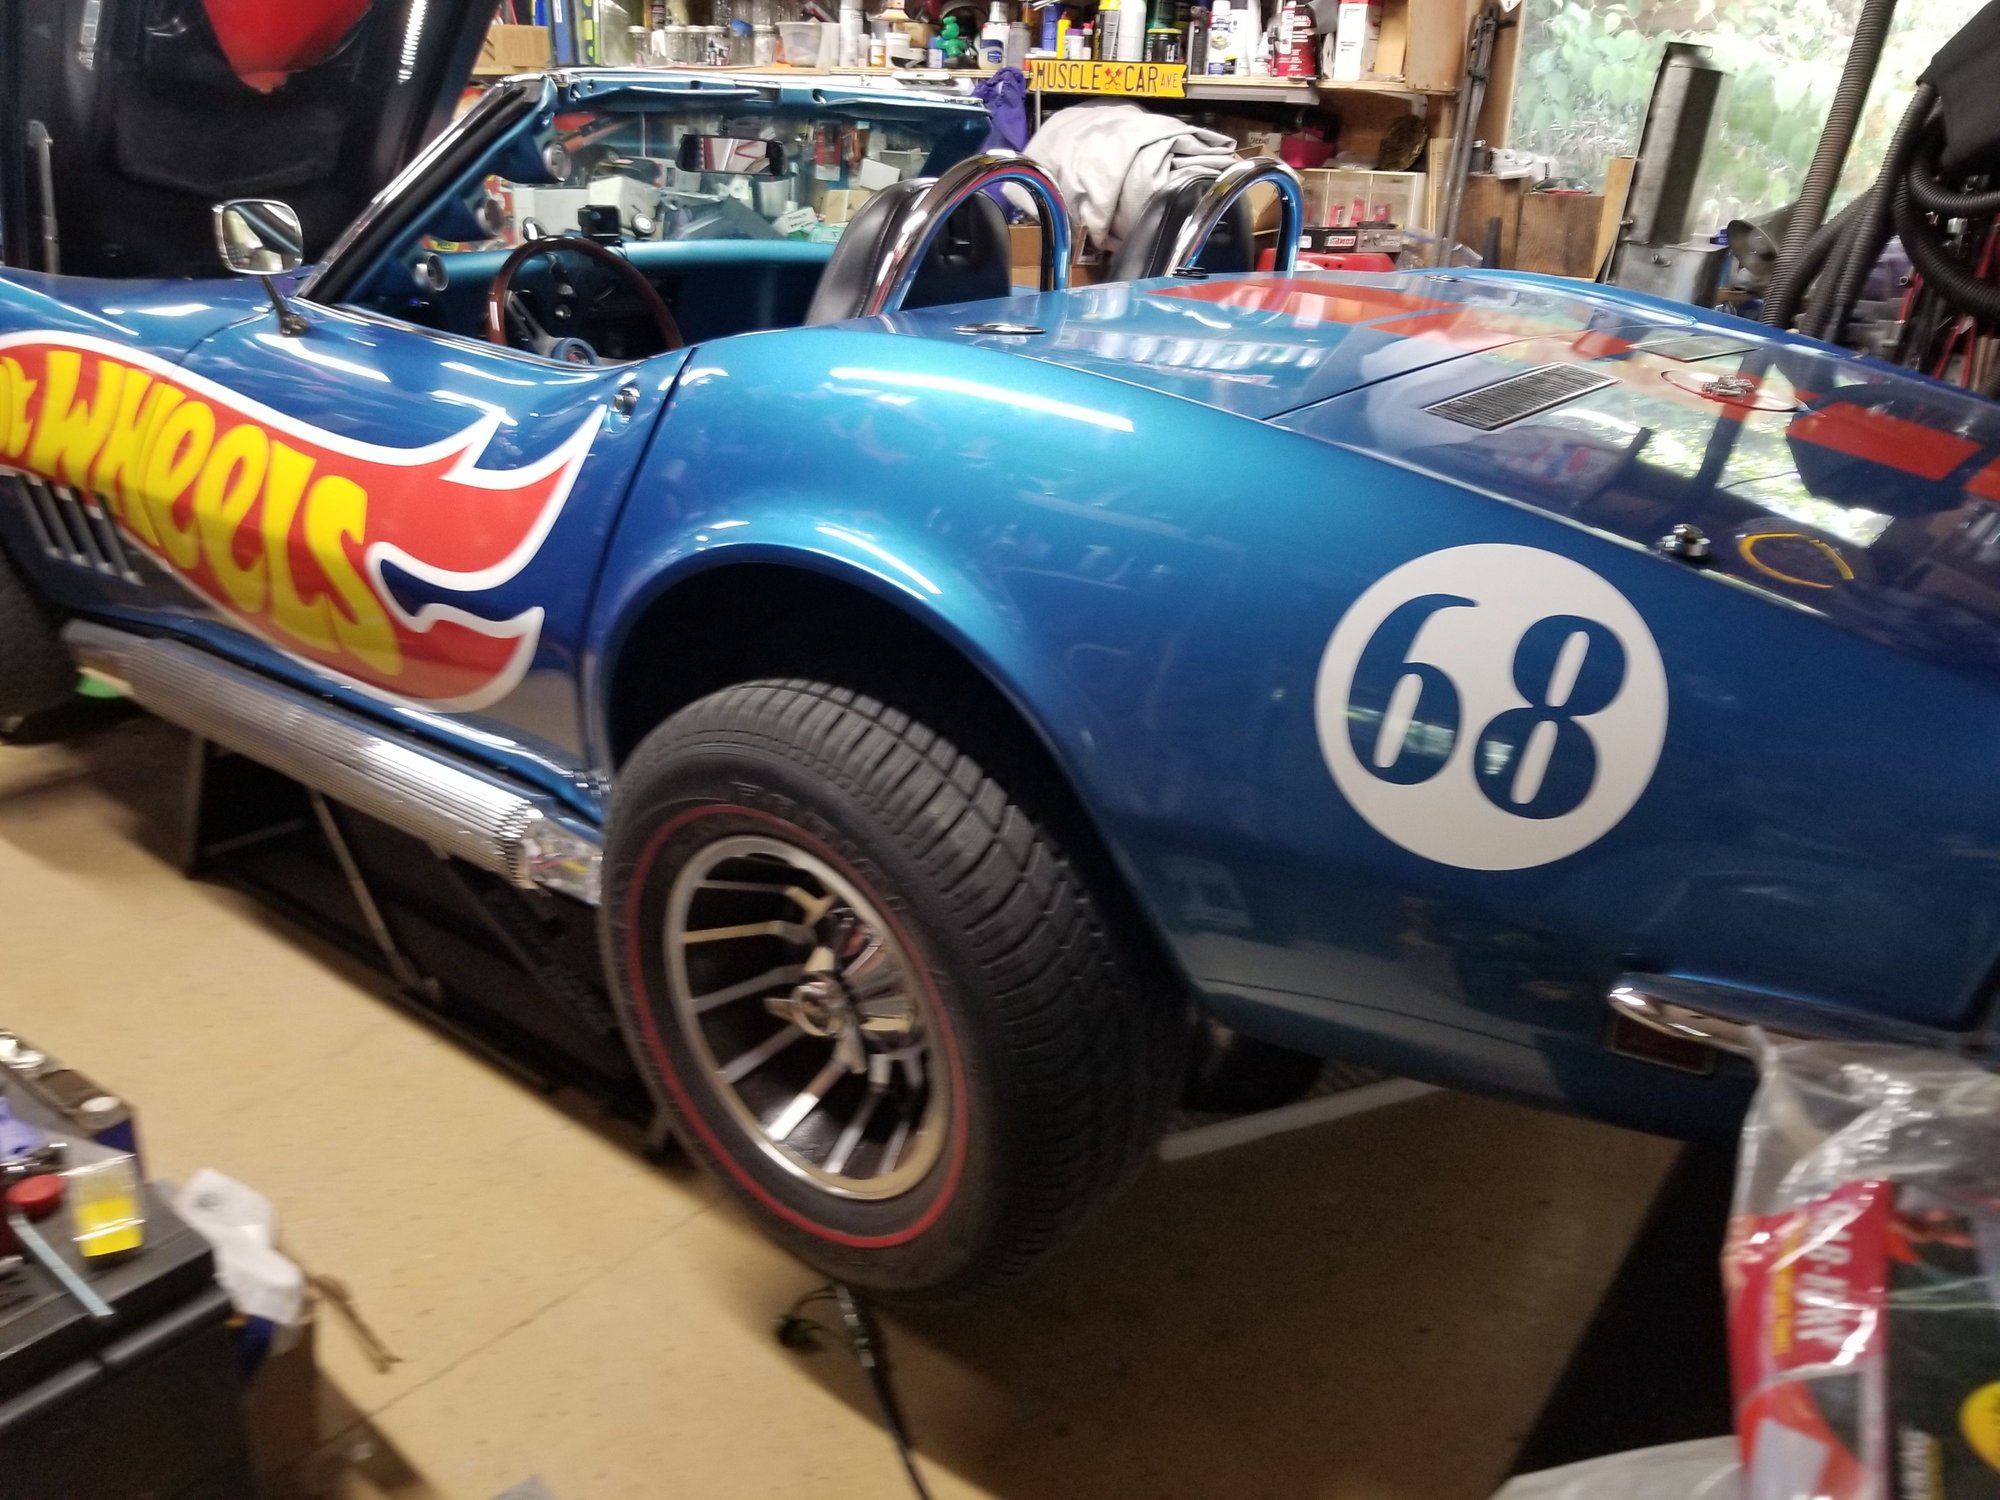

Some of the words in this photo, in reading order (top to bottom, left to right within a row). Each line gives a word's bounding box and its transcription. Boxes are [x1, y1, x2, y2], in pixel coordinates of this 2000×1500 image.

[1036, 62, 1103, 91] MUSCLE
[1124, 65, 1159, 93] CAR
[1160, 73, 1179, 89] AVE
[1346, 593, 1630, 820] 68
